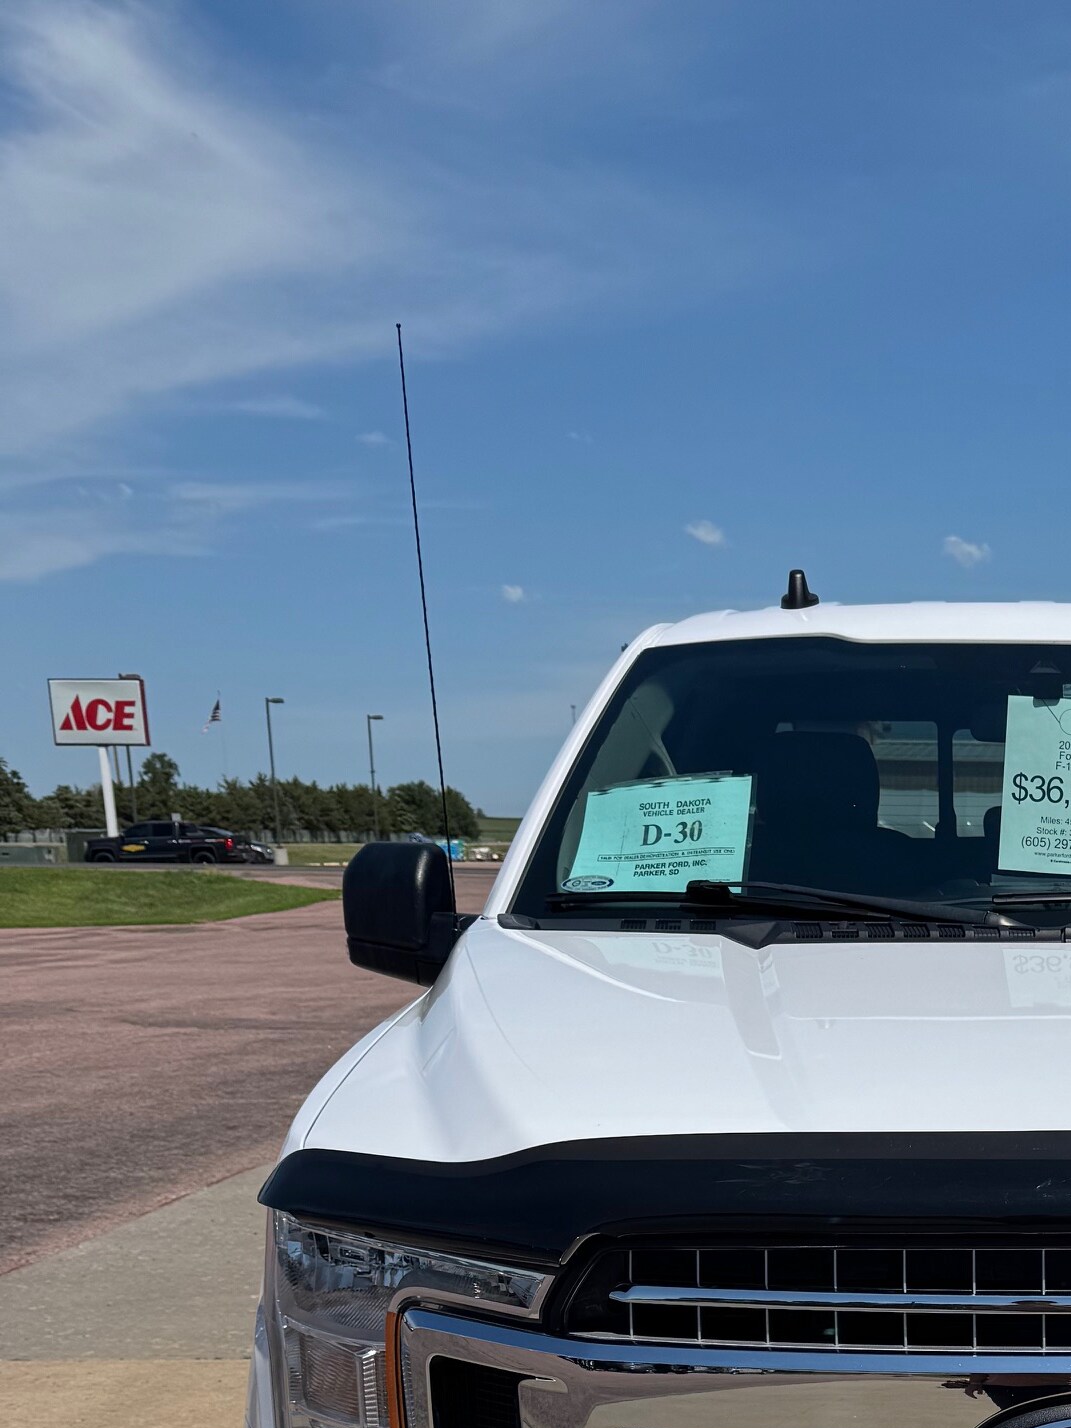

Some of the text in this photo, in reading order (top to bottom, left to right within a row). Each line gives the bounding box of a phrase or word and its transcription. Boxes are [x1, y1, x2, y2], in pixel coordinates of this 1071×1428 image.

[59, 694, 136, 731] ACE
[639, 798, 712, 811] SOUTH DAKOTA
[643, 807, 705, 817] VEHICLE DEALER
[1040, 816, 1064, 825] Miles:
[640, 820, 703, 847] D-30
[1036, 827, 1058, 836] Stock
[1059, 828, 1068, 836] #:
[1021, 836, 1051, 850] (605)
[635, 862, 666, 870] PARKER
